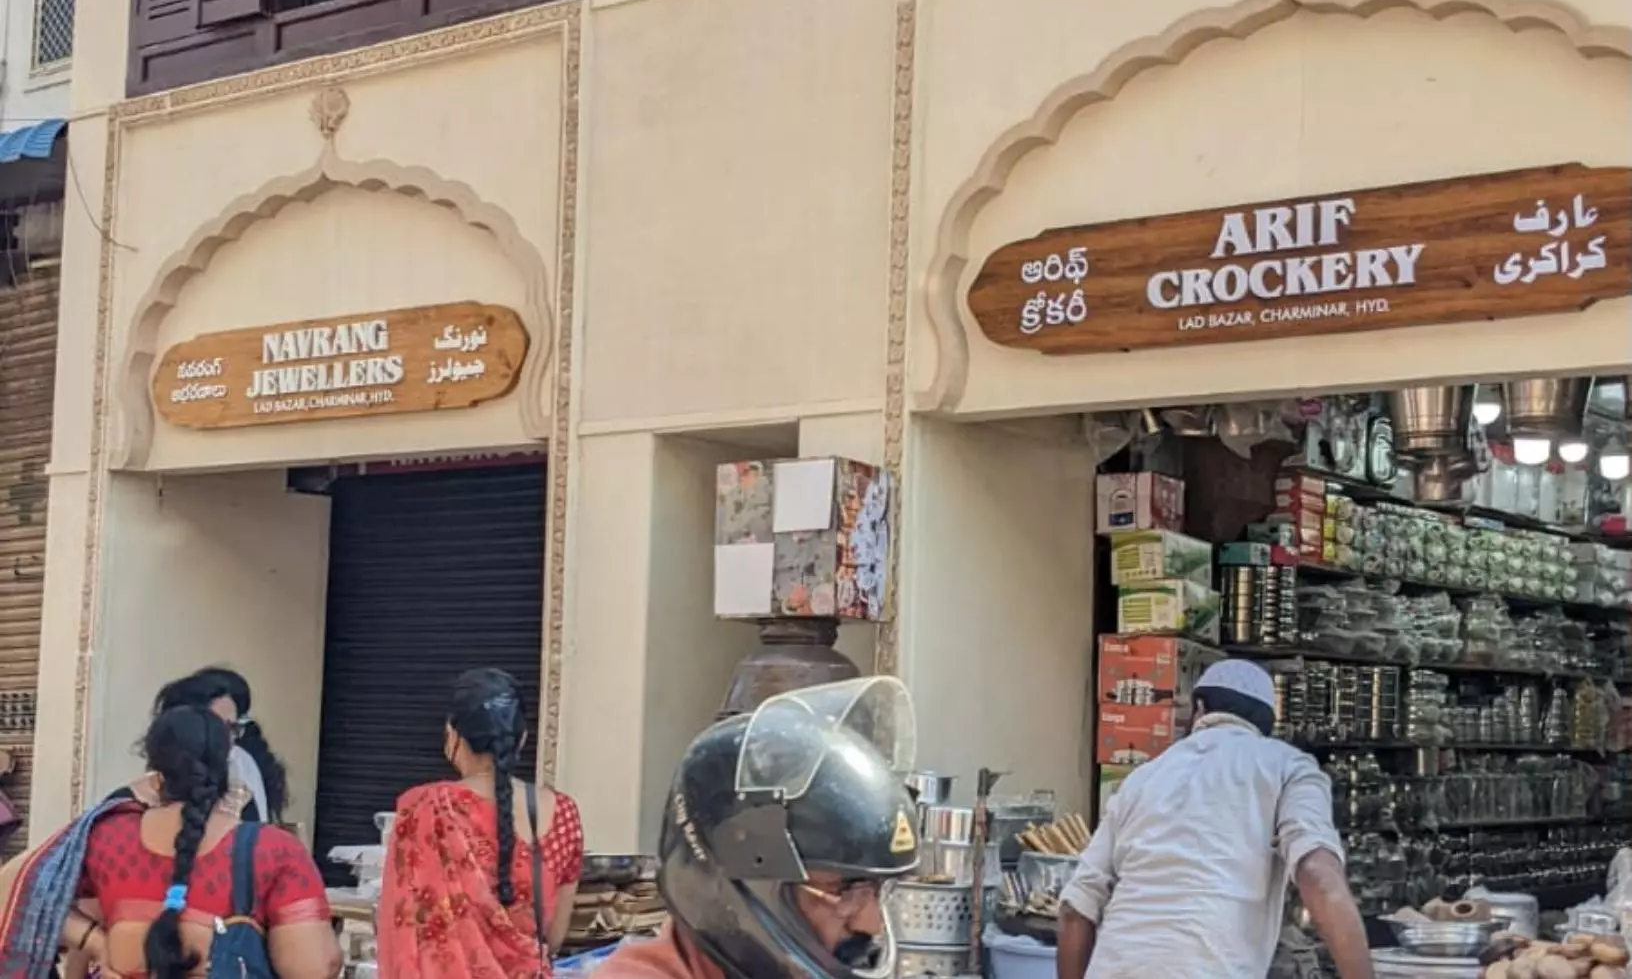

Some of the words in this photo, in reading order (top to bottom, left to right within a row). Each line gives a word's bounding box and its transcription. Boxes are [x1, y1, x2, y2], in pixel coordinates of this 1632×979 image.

[1210, 198, 1356, 259] ARIF
[1146, 244, 1427, 309] CROCKERY
[1178, 314, 1205, 331] LAD
[1208, 310, 1255, 328] BAZAR,
[1259, 301, 1350, 323] CHARMINAR,
[261, 320, 390, 365] NAVRANG
[244, 355, 405, 398] JEWELLERS
